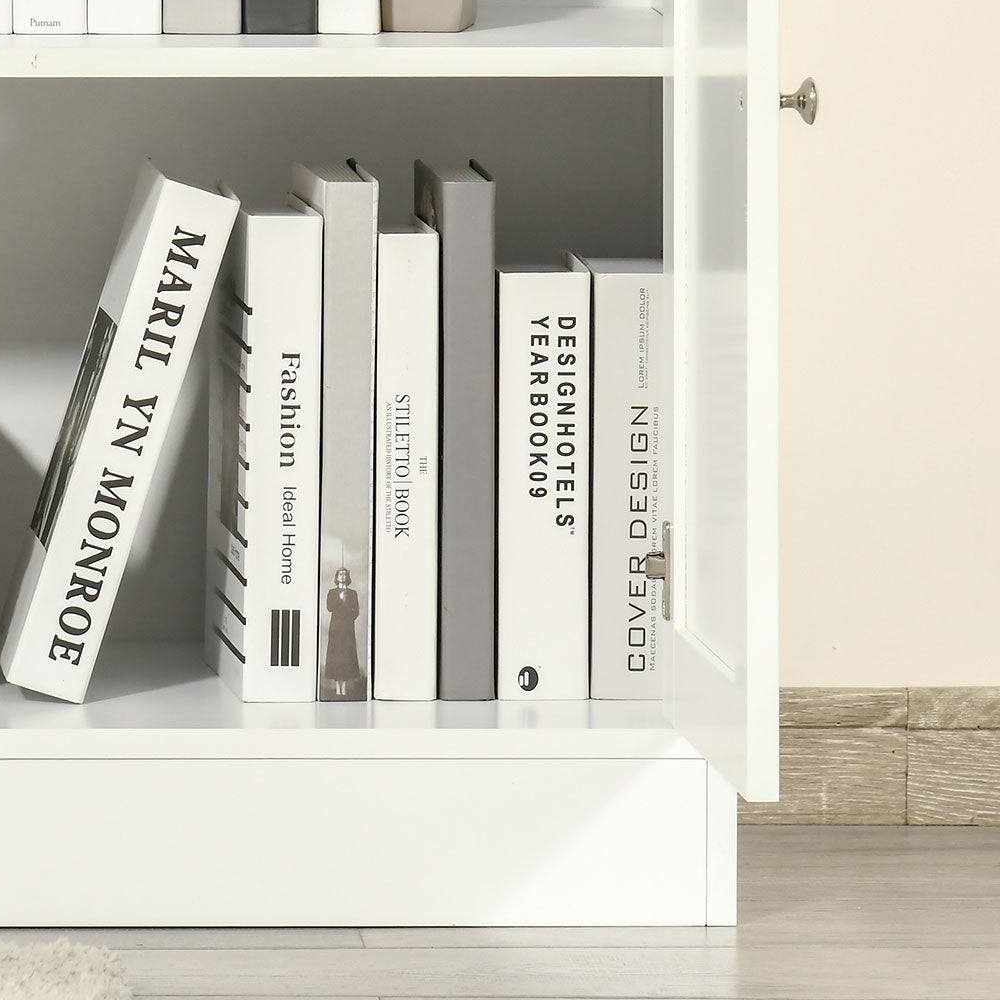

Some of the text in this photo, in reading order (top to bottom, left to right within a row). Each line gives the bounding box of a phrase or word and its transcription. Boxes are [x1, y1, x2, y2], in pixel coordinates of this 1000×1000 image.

[29, 17, 61, 27] Putnam
[638, 323, 646, 353] IPSUM
[637, 356, 646, 389] LOREM
[279, 351, 302, 585] Fashion Ideal Home
[394, 394, 411, 540] STILETTO BOOK
[418, 455, 428, 475] THE
[628, 405, 649, 671] COVER DESIGN
[48, 467, 135, 667] MONROE
[649, 616, 657, 671] MAECENAS
